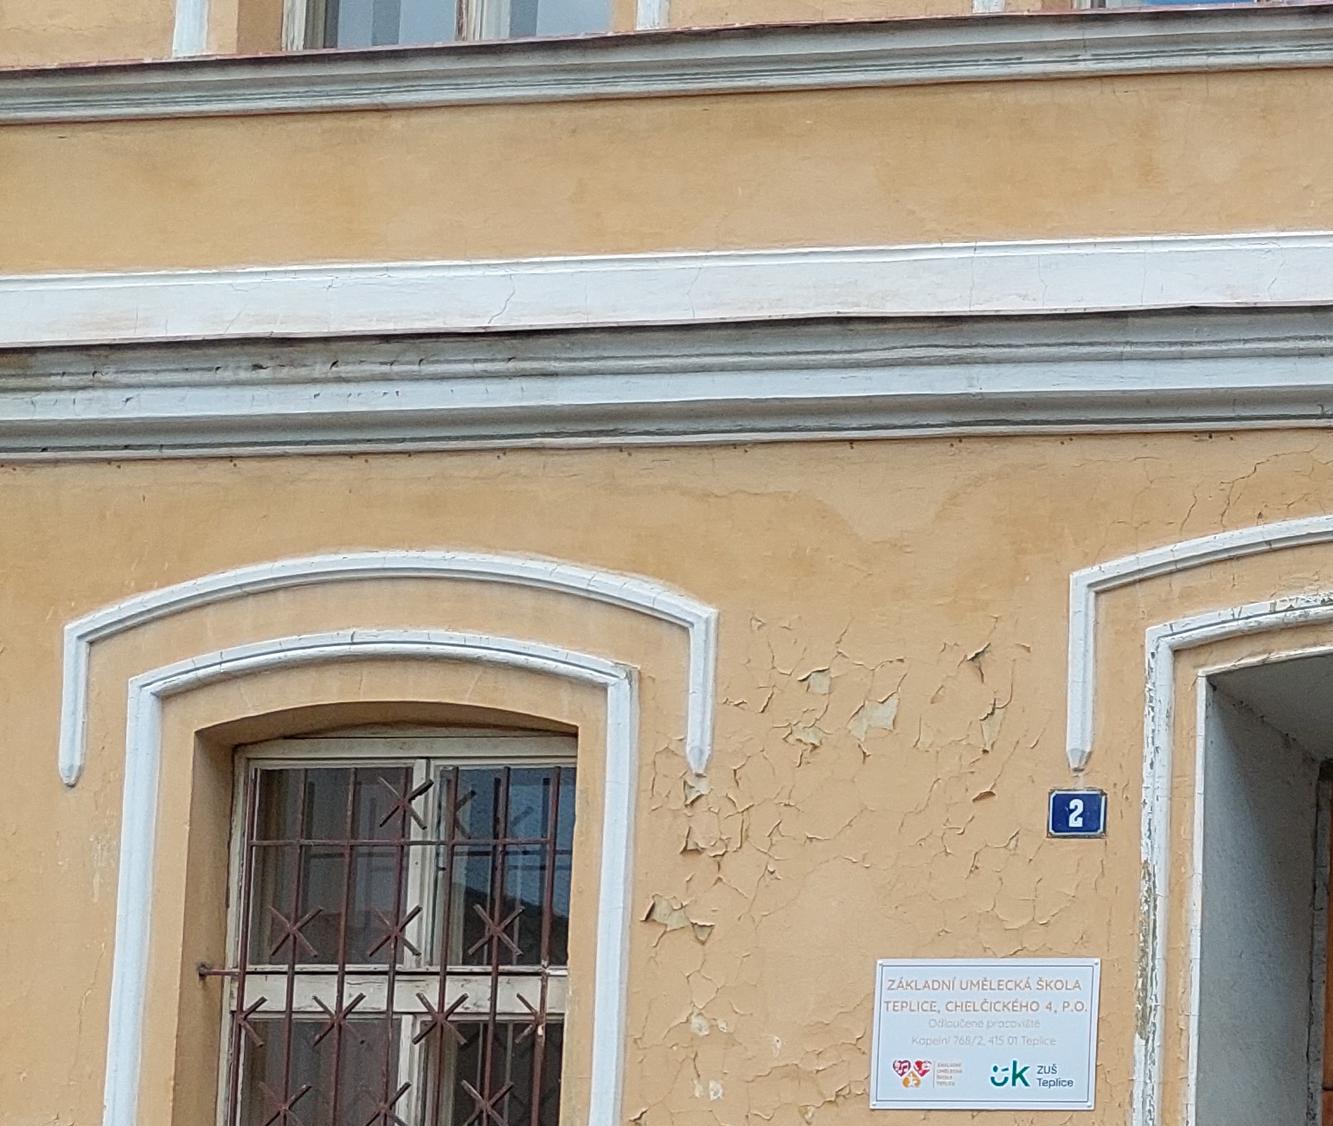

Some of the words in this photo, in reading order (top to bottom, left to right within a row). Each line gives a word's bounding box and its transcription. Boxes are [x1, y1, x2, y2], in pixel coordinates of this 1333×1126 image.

[1068, 798, 1084, 828] 2
[887, 976, 956, 991] ZÁKLADNÍ
[960, 976, 1032, 991] UMĚLECKÁ
[1036, 976, 1082, 991] ŠKOLA
[883, 1000, 941, 1014] TEPLICE,
[945, 997, 1040, 1013] CHELČICKÉHO
[1062, 1000, 1088, 1013] P.O.
[1036, 1063, 1058, 1075] ZUŠ
[1036, 1076, 1074, 1089] Teplice
